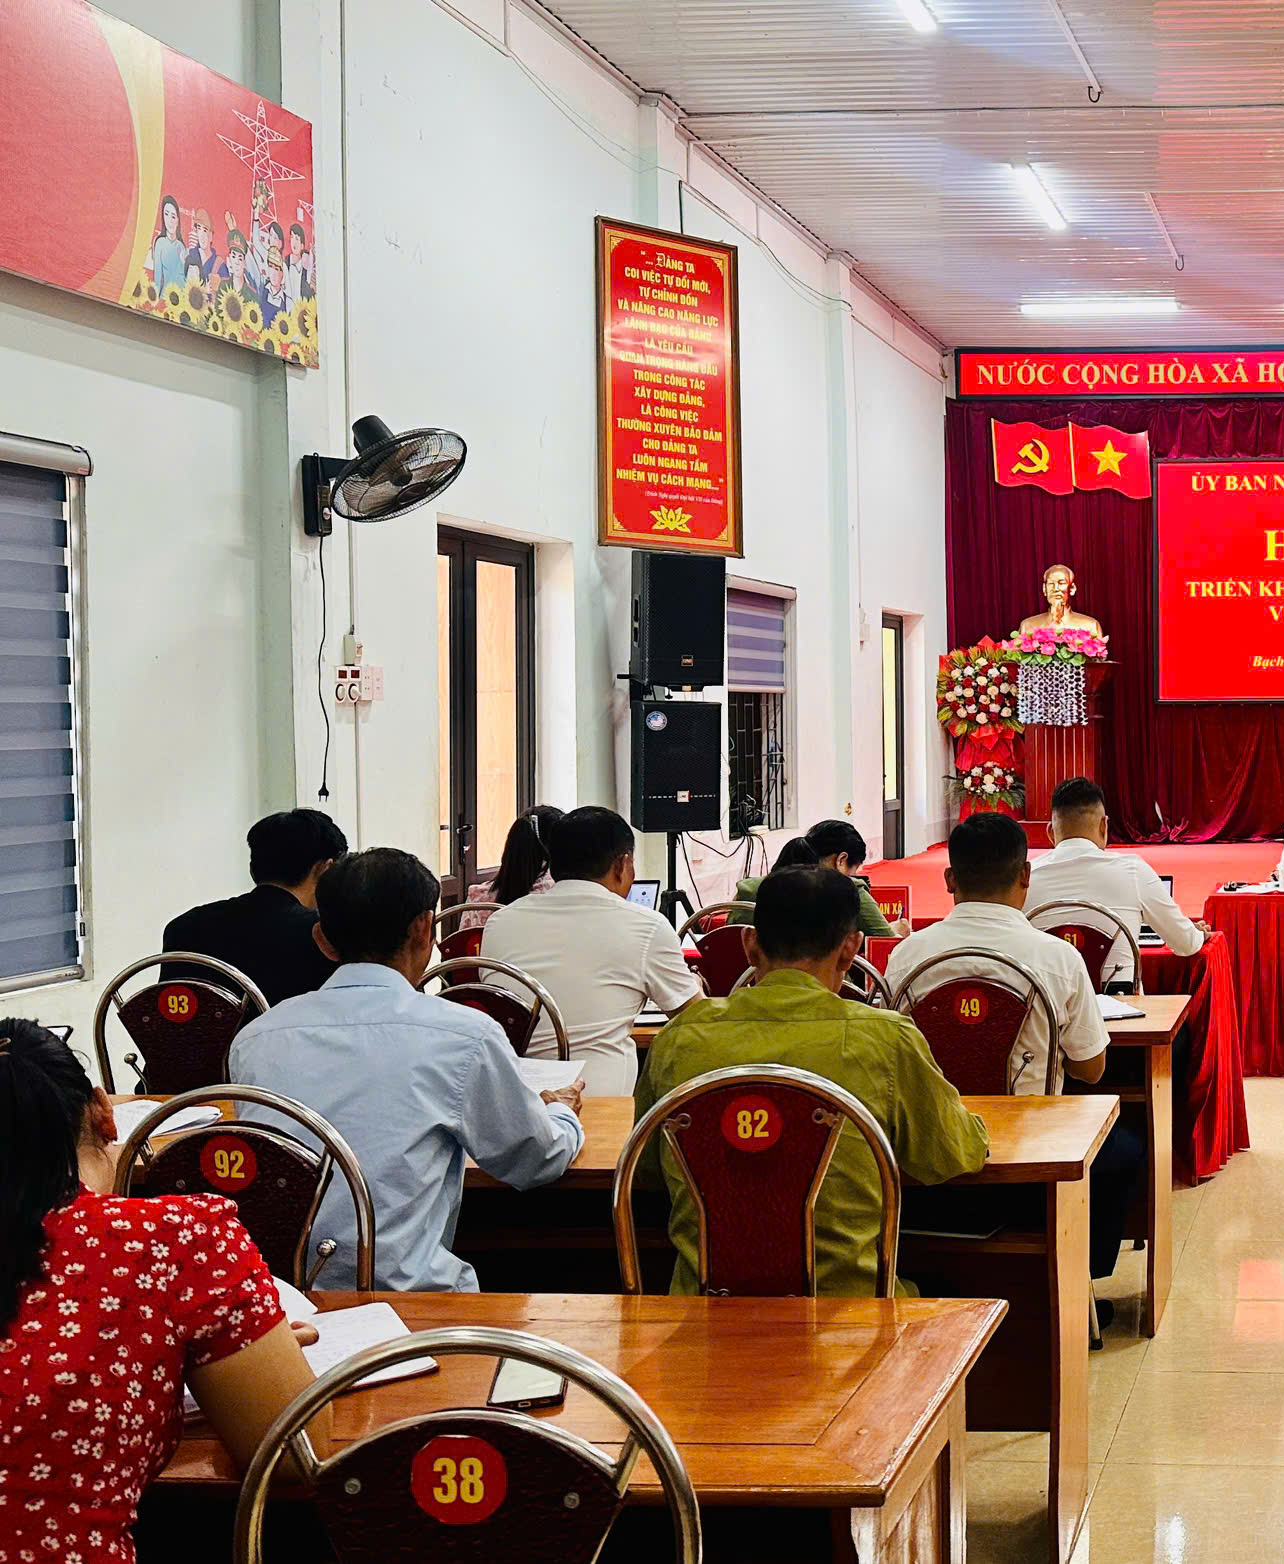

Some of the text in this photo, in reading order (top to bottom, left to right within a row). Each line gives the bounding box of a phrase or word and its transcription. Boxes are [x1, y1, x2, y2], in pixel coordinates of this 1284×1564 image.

[625, 267, 639, 278] COI
[642, 270, 660, 283] VIỆC
[663, 274, 673, 287] TỰ
[686, 262, 695, 273] TA
[639, 286, 650, 299] TỰ
[652, 287, 678, 303] CHỈNH
[618, 298, 629, 311] VÀ
[631, 301, 656, 315] NÂNG
[658, 307, 675, 319] CAO
[703, 315, 718, 328] LỰC
[633, 369, 705, 390] TRONG CÔNG TÁC
[977, 359, 1055, 386] NƯỚC
[1062, 361, 1139, 390] CỘNG
[1147, 358, 1205, 384] HÒA
[1211, 358, 1248, 383] XÃ
[634, 385, 651, 398] XÂY
[654, 389, 677, 403] DỰNG
[641, 403, 698, 423] LÀ CÔNG VIỆC
[616, 417, 722, 442] THƯỜNG XUYÊN BẢO ĐẢM
[643, 438, 697, 455] CHO ĐẢNG TA
[633, 453, 655, 466] LUÔN
[658, 457, 687, 470] NGANG
[616, 468, 645, 482] NHIỆM
[648, 472, 658, 485] VỤ
[661, 473, 684, 486] CÁCH
[1191, 472, 1220, 491] ỦY
[1225, 475, 1266, 491] BAN
[1186, 576, 1251, 597] TRIỂN
[1253, 655, 1284, 669] Bạch
[168, 996, 188, 1014] 93
[960, 998, 980, 1018] 49
[737, 1110, 769, 1139] 82
[214, 1150, 245, 1178] 92
[433, 1458, 484, 1504] 38
